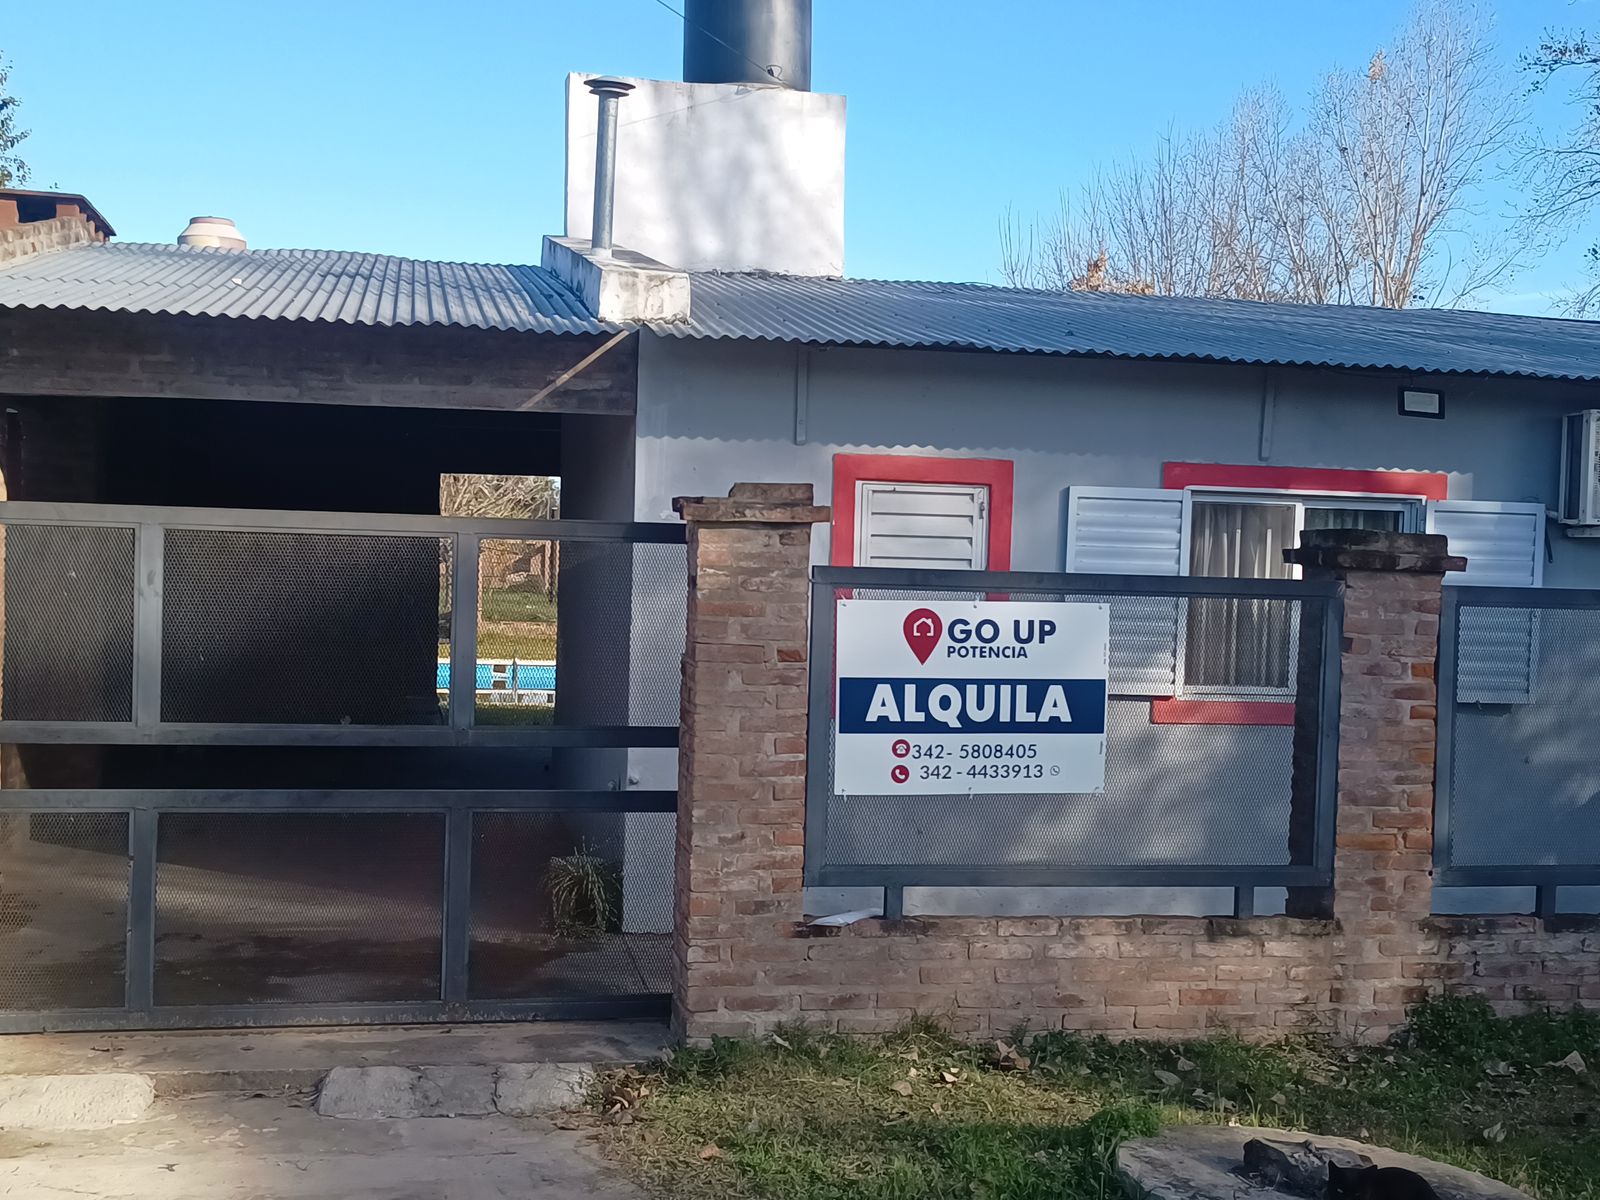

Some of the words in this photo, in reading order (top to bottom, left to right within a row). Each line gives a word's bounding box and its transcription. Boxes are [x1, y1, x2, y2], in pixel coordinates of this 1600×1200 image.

[947, 618, 1000, 644] GO
[1013, 619, 1057, 644] UP
[947, 645, 1028, 659] POTENCIA
[865, 683, 1073, 728] ALQUILA
[959, 744, 1037, 759] 5808405
